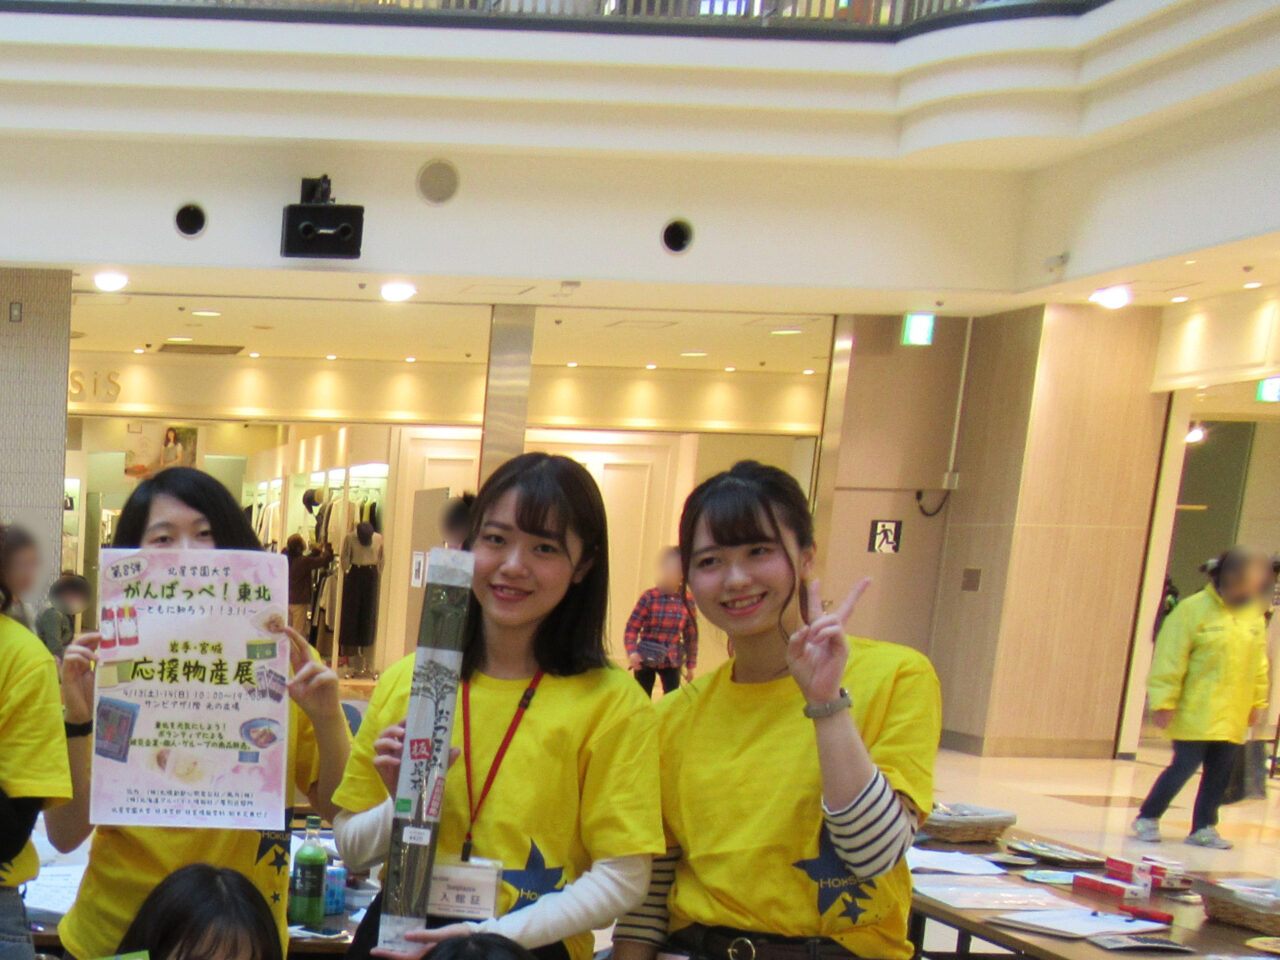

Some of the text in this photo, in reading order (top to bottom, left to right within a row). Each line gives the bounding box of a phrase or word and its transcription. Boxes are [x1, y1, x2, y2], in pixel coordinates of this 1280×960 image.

[131, 657, 257, 686] 応援物産展
